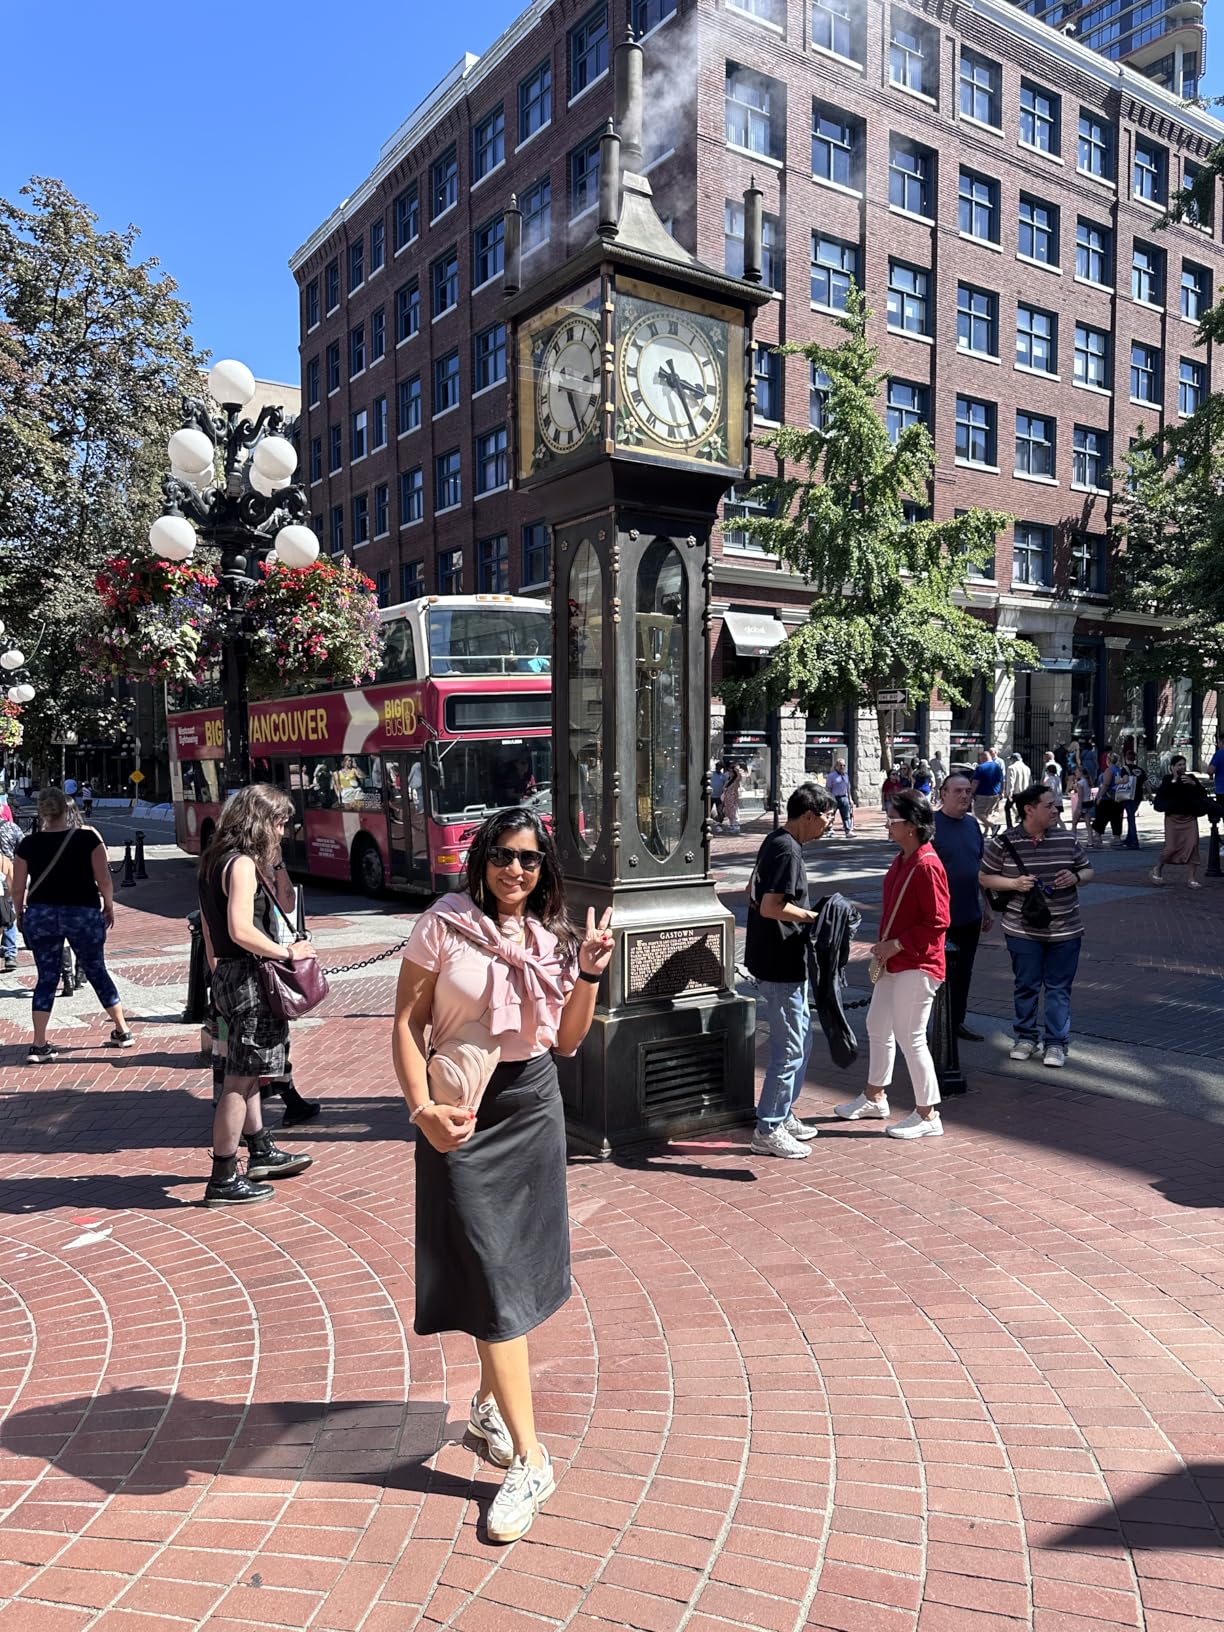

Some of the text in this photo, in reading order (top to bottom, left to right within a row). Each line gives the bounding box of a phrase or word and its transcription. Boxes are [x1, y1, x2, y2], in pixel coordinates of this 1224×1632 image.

[384, 699, 401, 718] BIG
[205, 719, 223, 746] BIG
[385, 719, 403, 736] BUS
[660, 930, 694, 939] GASTOWN
